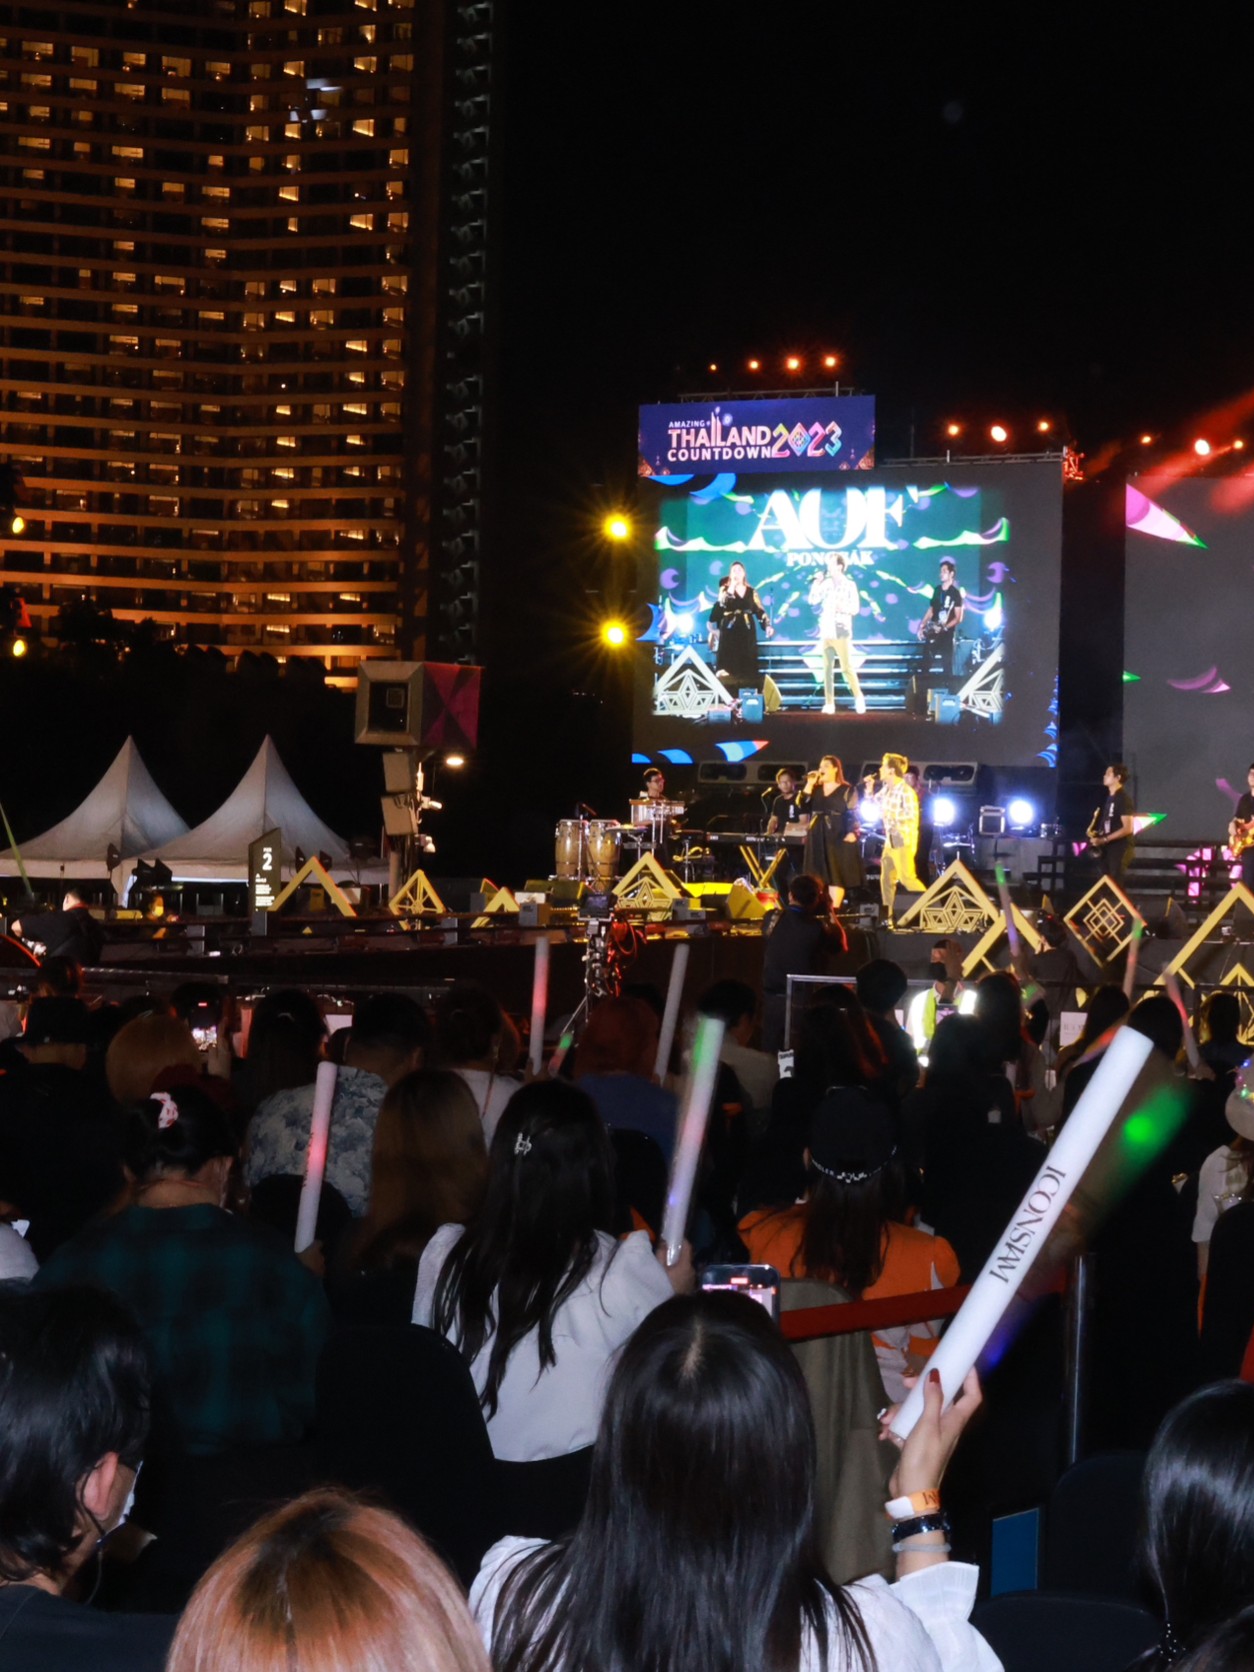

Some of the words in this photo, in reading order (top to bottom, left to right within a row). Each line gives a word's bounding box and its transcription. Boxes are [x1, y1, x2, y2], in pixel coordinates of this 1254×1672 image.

[667, 412, 772, 448] THAILAND
[668, 420, 706, 428] AMAZING
[771, 420, 842, 458] 2023
[667, 446, 772, 462] COUNTDOWN
[748, 486, 918, 551] AOF
[262, 852, 272, 870] 2
[988, 1165, 1066, 1284] ICONSIAM
